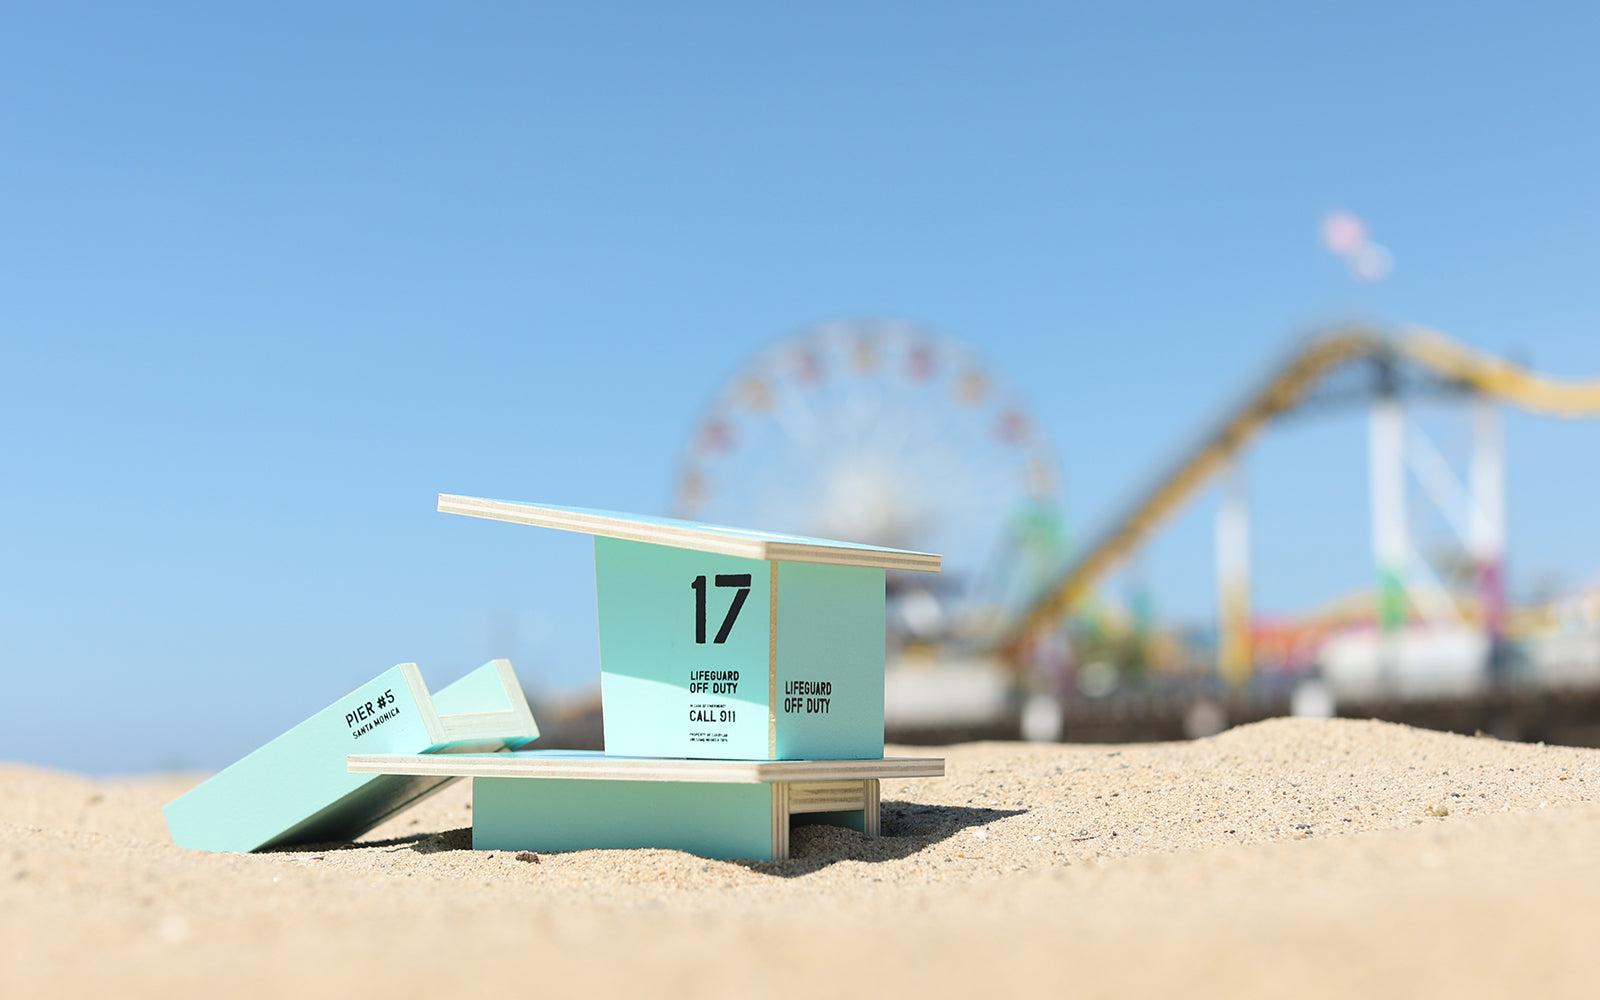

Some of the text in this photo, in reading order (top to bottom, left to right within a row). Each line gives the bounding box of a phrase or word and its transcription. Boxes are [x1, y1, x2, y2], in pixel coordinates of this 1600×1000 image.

[691, 574, 752, 644] 17
[690, 670, 740, 681] LIFEGUARD
[689, 683, 738, 694] OFF DUTY
[785, 681, 832, 696] LIFEGUARD
[345, 689, 395, 728] PIER #5
[784, 698, 831, 714] OFF DUTY
[352, 707, 400, 739] SANTA MONICA
[689, 710, 736, 722] CALL 911
